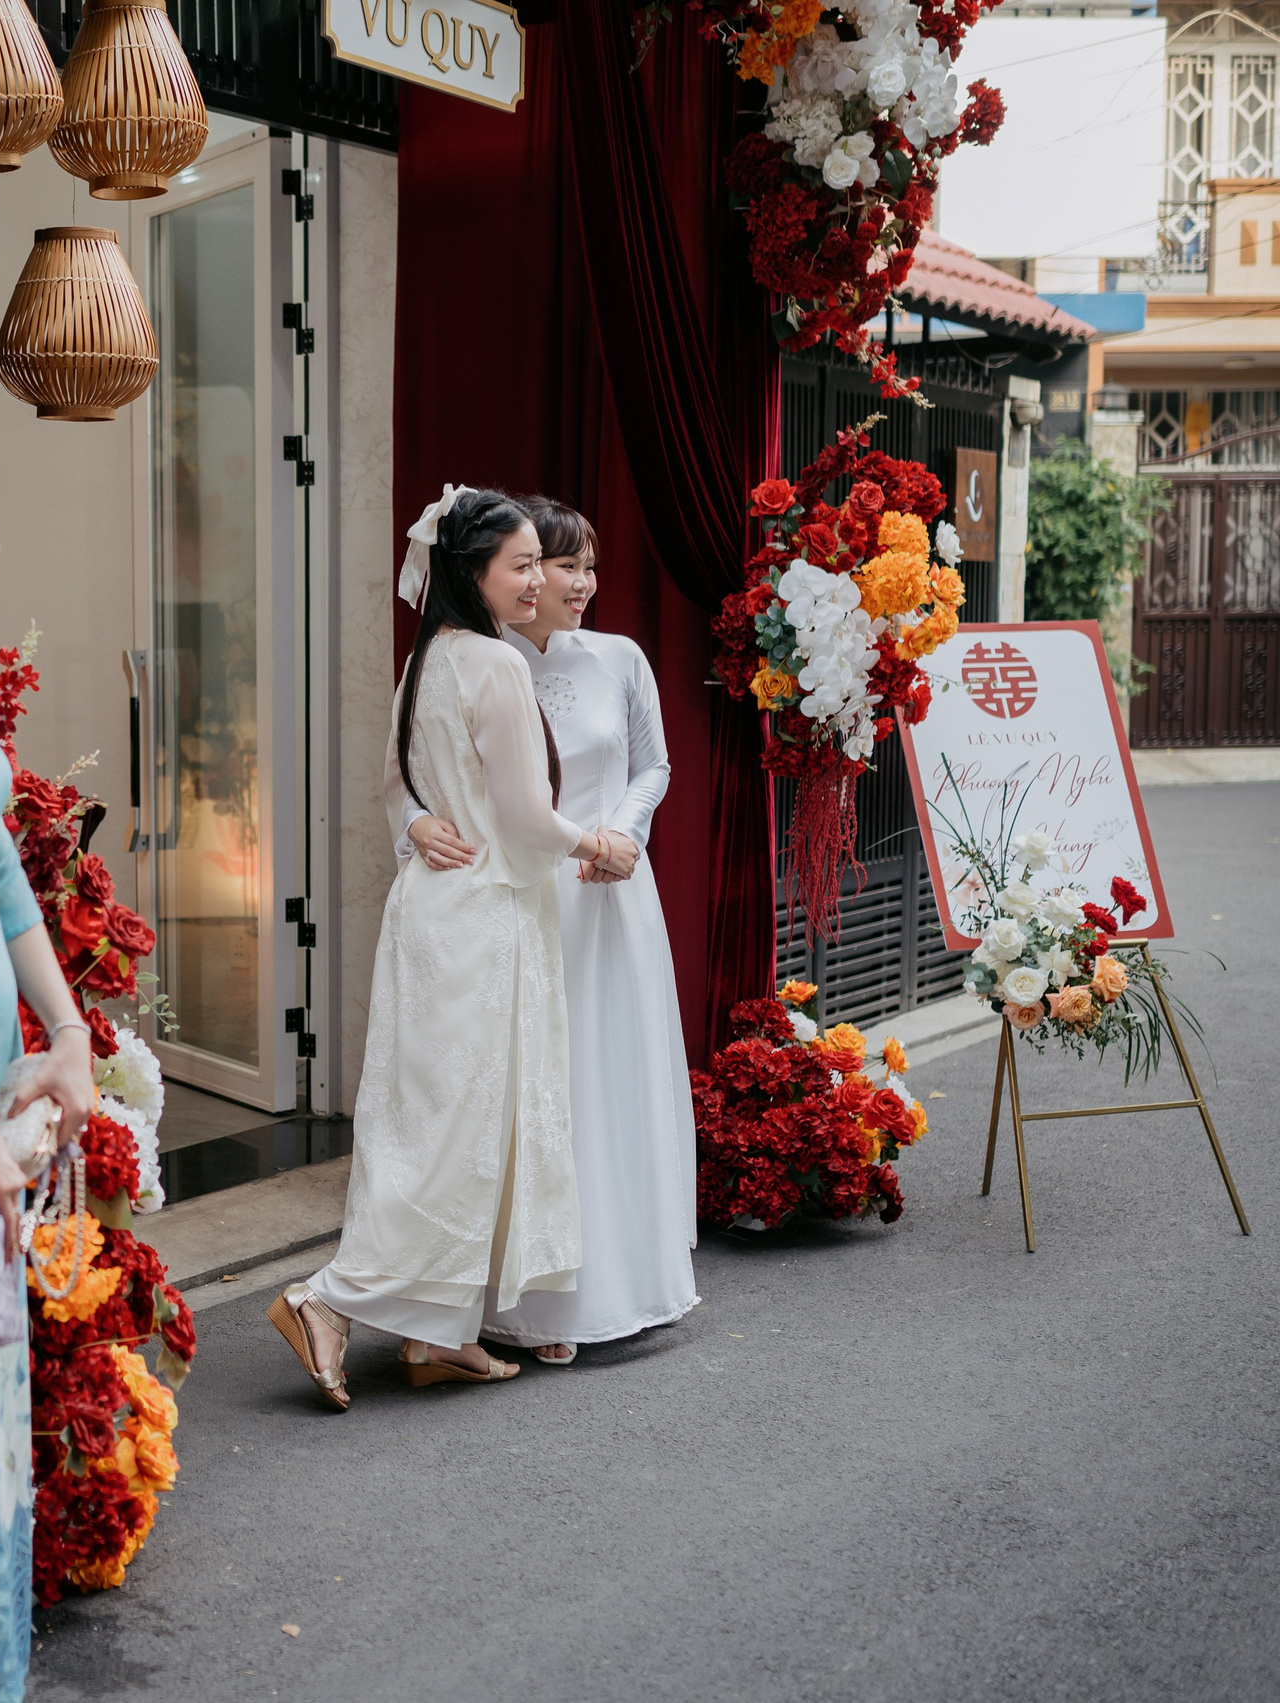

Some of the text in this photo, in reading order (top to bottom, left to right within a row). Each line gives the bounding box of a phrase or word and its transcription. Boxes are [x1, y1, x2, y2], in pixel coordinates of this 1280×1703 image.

[361, 0, 501, 79] VU QUY
[1021, 731, 1059, 747] QUY
